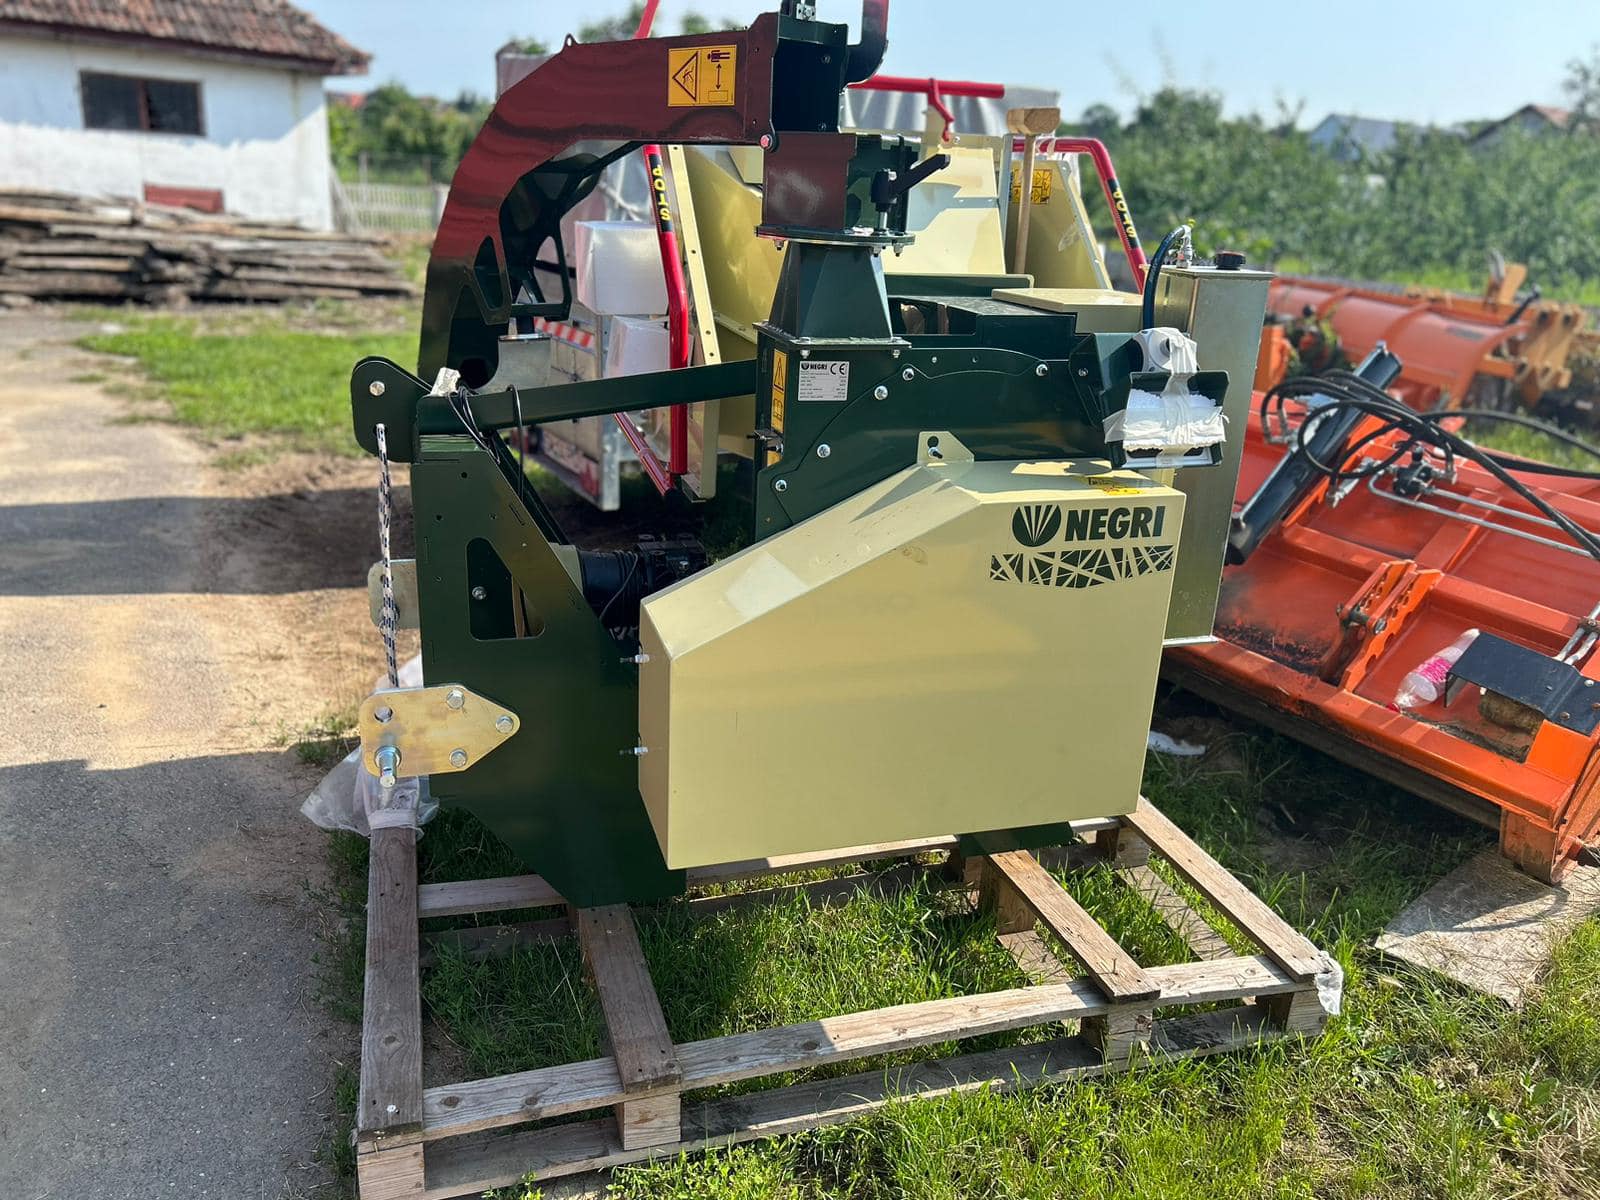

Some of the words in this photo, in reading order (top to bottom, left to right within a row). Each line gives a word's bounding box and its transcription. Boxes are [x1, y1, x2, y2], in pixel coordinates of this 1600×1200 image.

[652, 164, 671, 221] STOP
[1113, 187, 1136, 238] STOP
[1064, 505, 1166, 542] NEGRI
